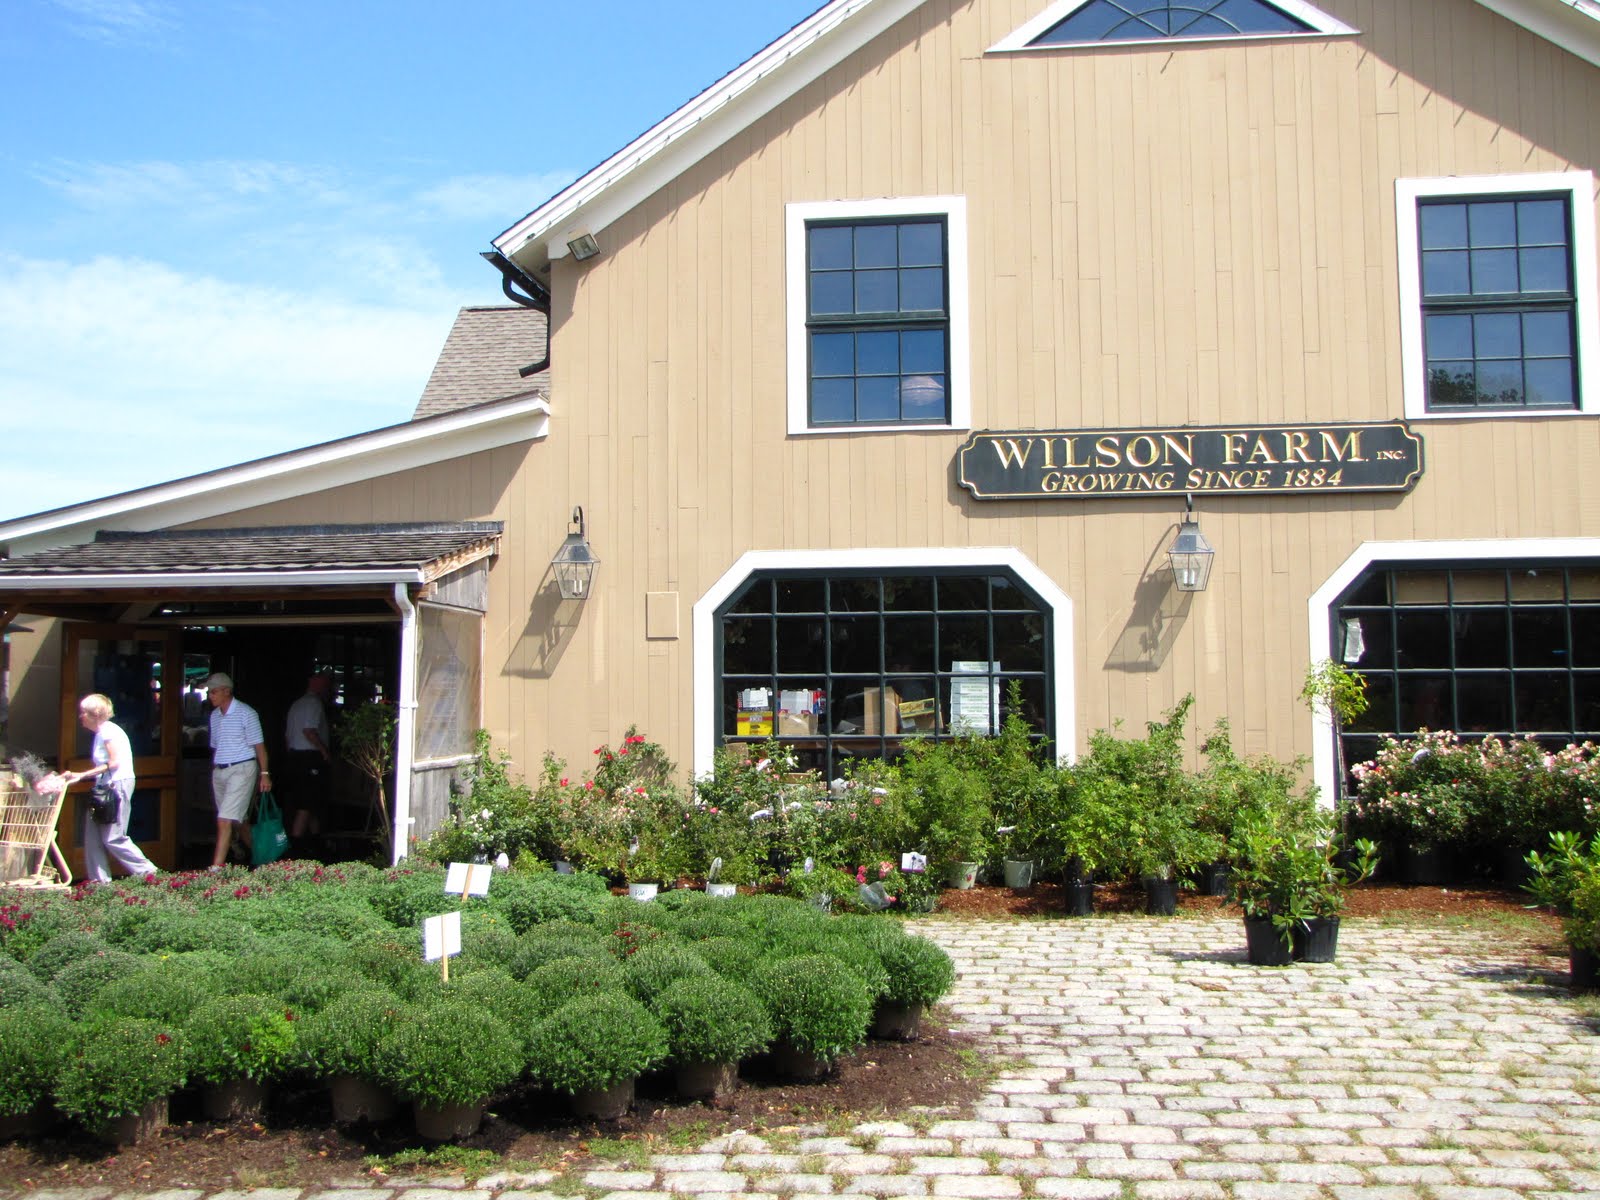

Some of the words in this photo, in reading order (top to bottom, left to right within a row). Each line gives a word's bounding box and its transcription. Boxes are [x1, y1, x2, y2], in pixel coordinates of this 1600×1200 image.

[990, 433, 1196, 470] WILSON
[1376, 450, 1406, 460] INC.
[1041, 471, 1175, 492] GROWING
[1184, 467, 1272, 489] SINCE
[1281, 467, 1344, 488] 1884
